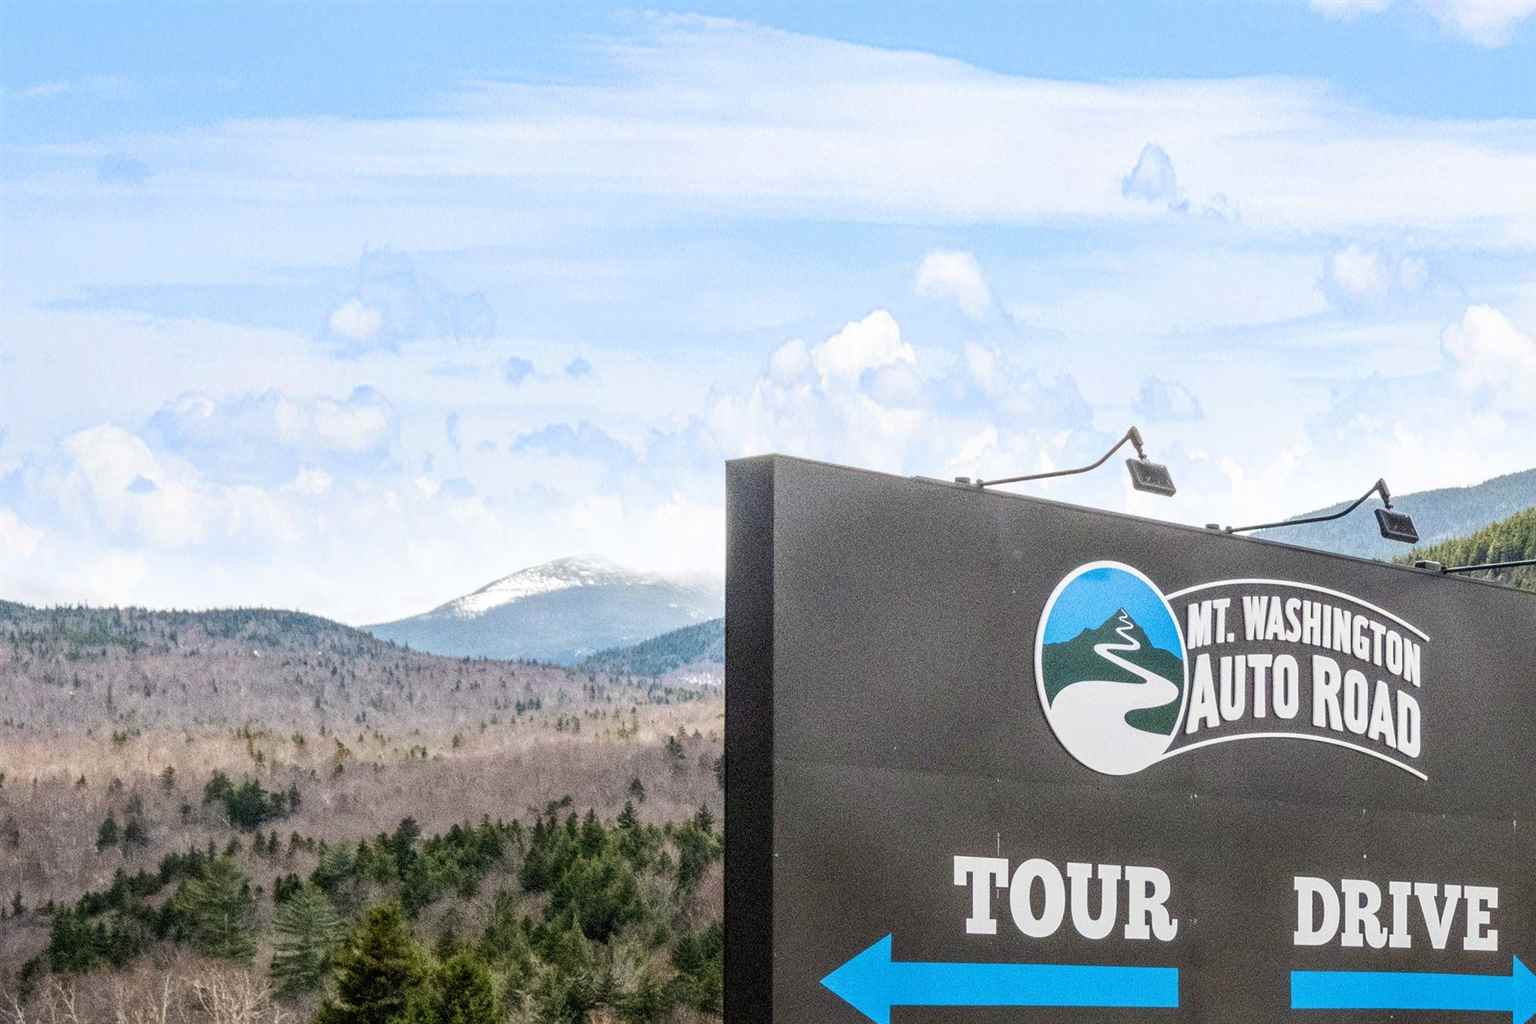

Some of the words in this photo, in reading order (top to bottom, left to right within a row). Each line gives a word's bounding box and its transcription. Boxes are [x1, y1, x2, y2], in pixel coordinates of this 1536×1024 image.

[1186, 597, 1234, 650] MT.
[1242, 595, 1422, 688] WASHINGTON
[1185, 652, 1300, 735] AUTO
[1312, 654, 1422, 759] ROAD
[953, 855, 1179, 942] TOUR
[1293, 875, 1499, 952] DRIVE
